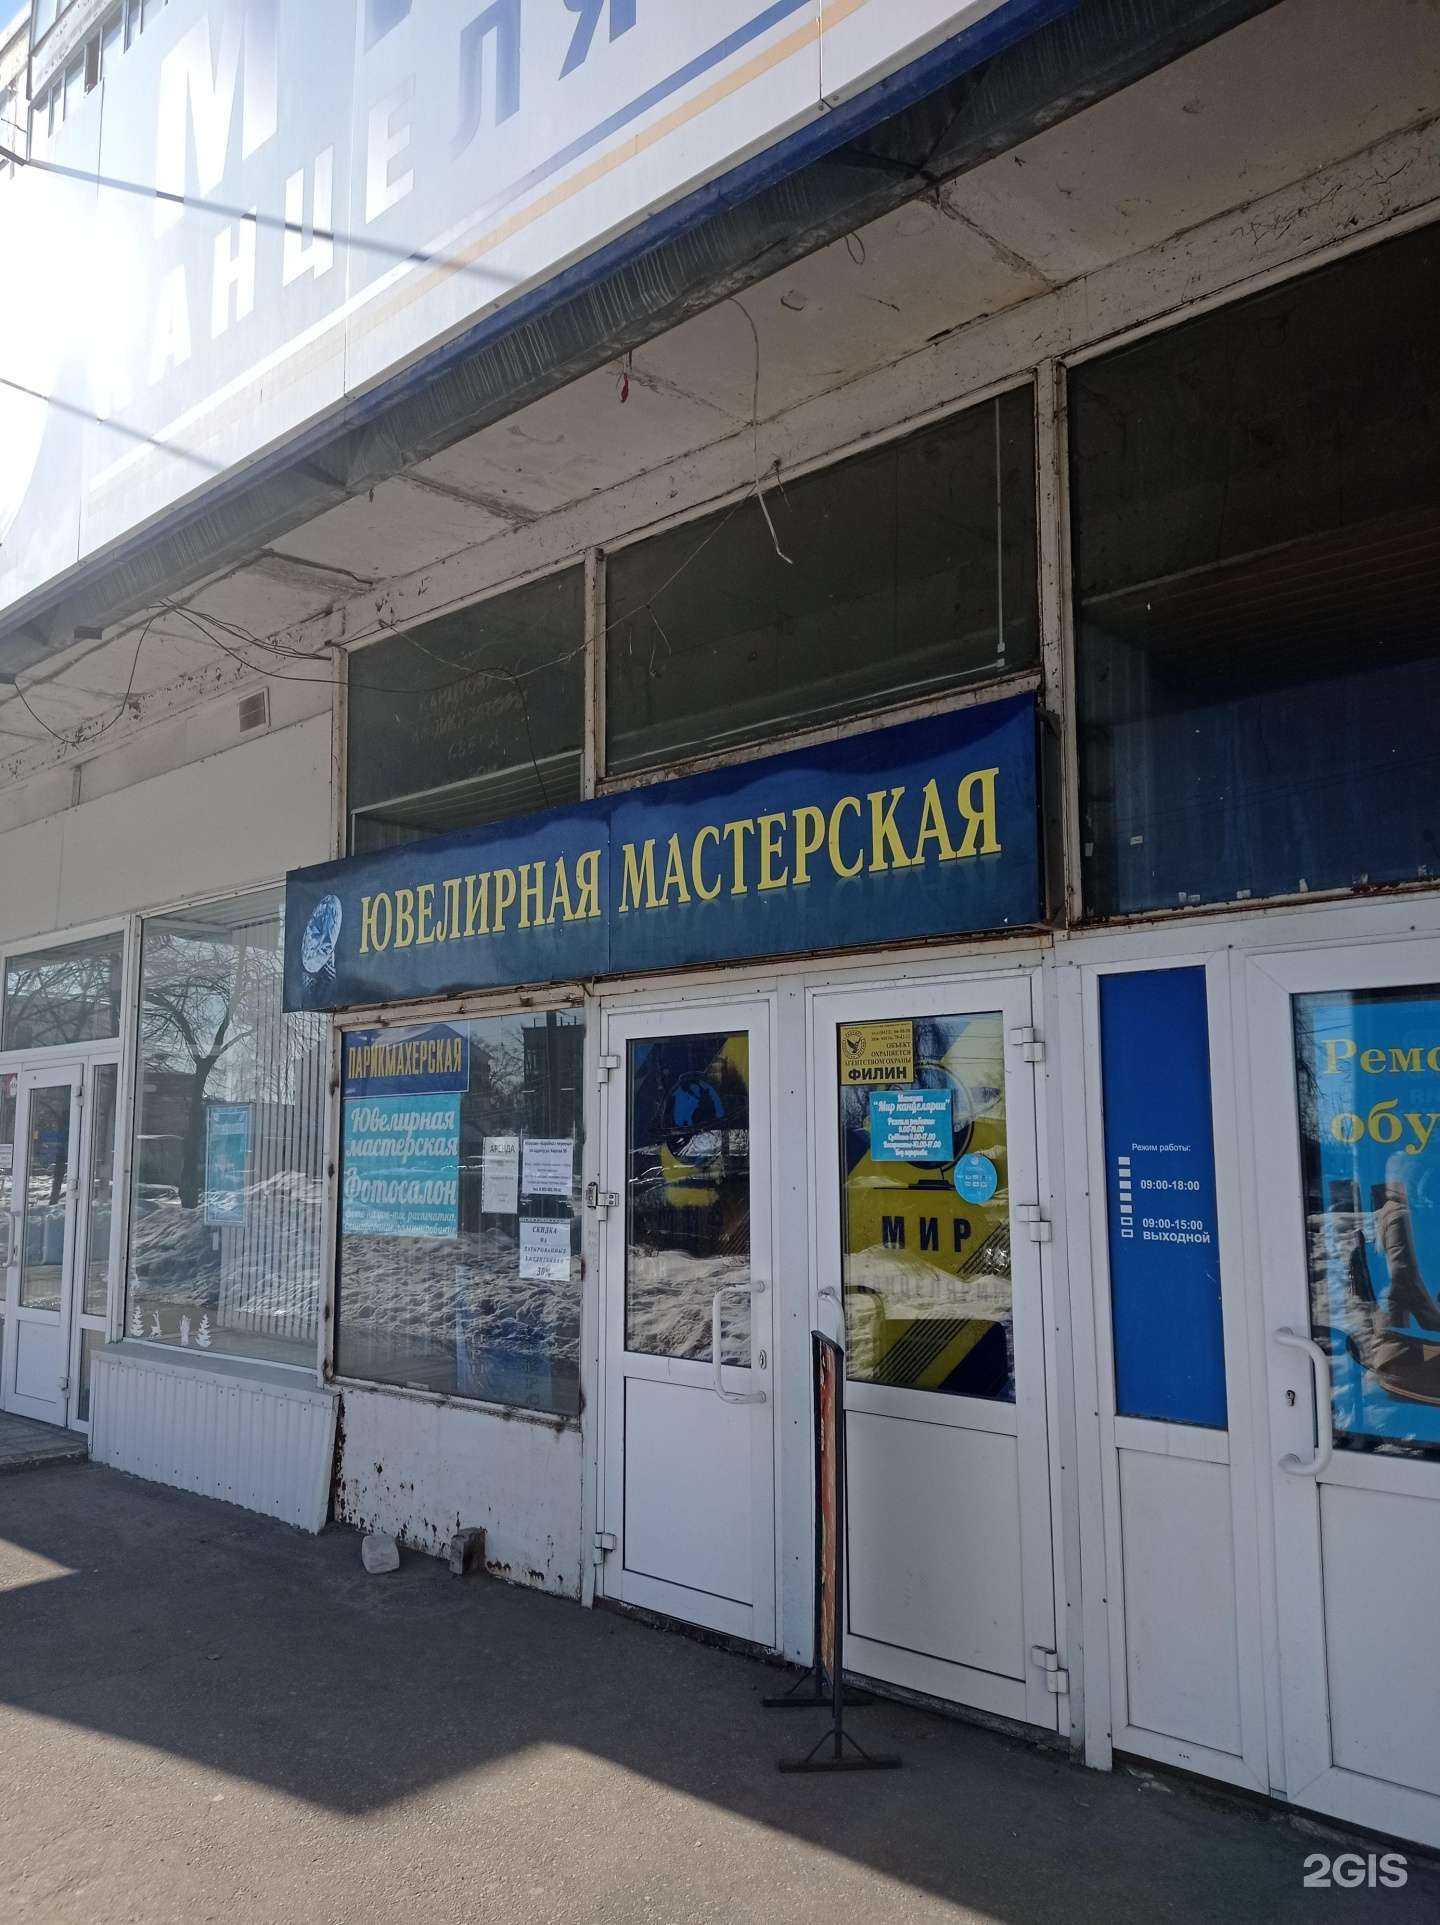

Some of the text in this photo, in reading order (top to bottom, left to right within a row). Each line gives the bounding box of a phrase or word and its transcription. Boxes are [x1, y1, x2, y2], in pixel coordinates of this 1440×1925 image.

[359, 767, 1002, 954] ЮВЕЛИРНАЯ МАСТЕРСКАЯ
[348, 1037, 462, 1079] ПАРИКМАХЕРСКАЯ
[848, 1066, 907, 1080] ФИЛИН
[351, 1106, 456, 1139] Ювелирная
[1331, 1097, 1440, 1154] обу
[346, 1135, 460, 1164] мастерская
[489, 1144, 516, 1154] АРЕНДА
[1132, 1144, 1191, 1152] Режим работы:
[343, 1166, 457, 1205] Фотосалон
[1141, 1180, 1200, 1190] 09:00-18:00
[532, 1226, 558, 1234] СКИДКА
[882, 1215, 971, 1252] МИР
[1142, 1218, 1203, 1230] 09:00-15:00
